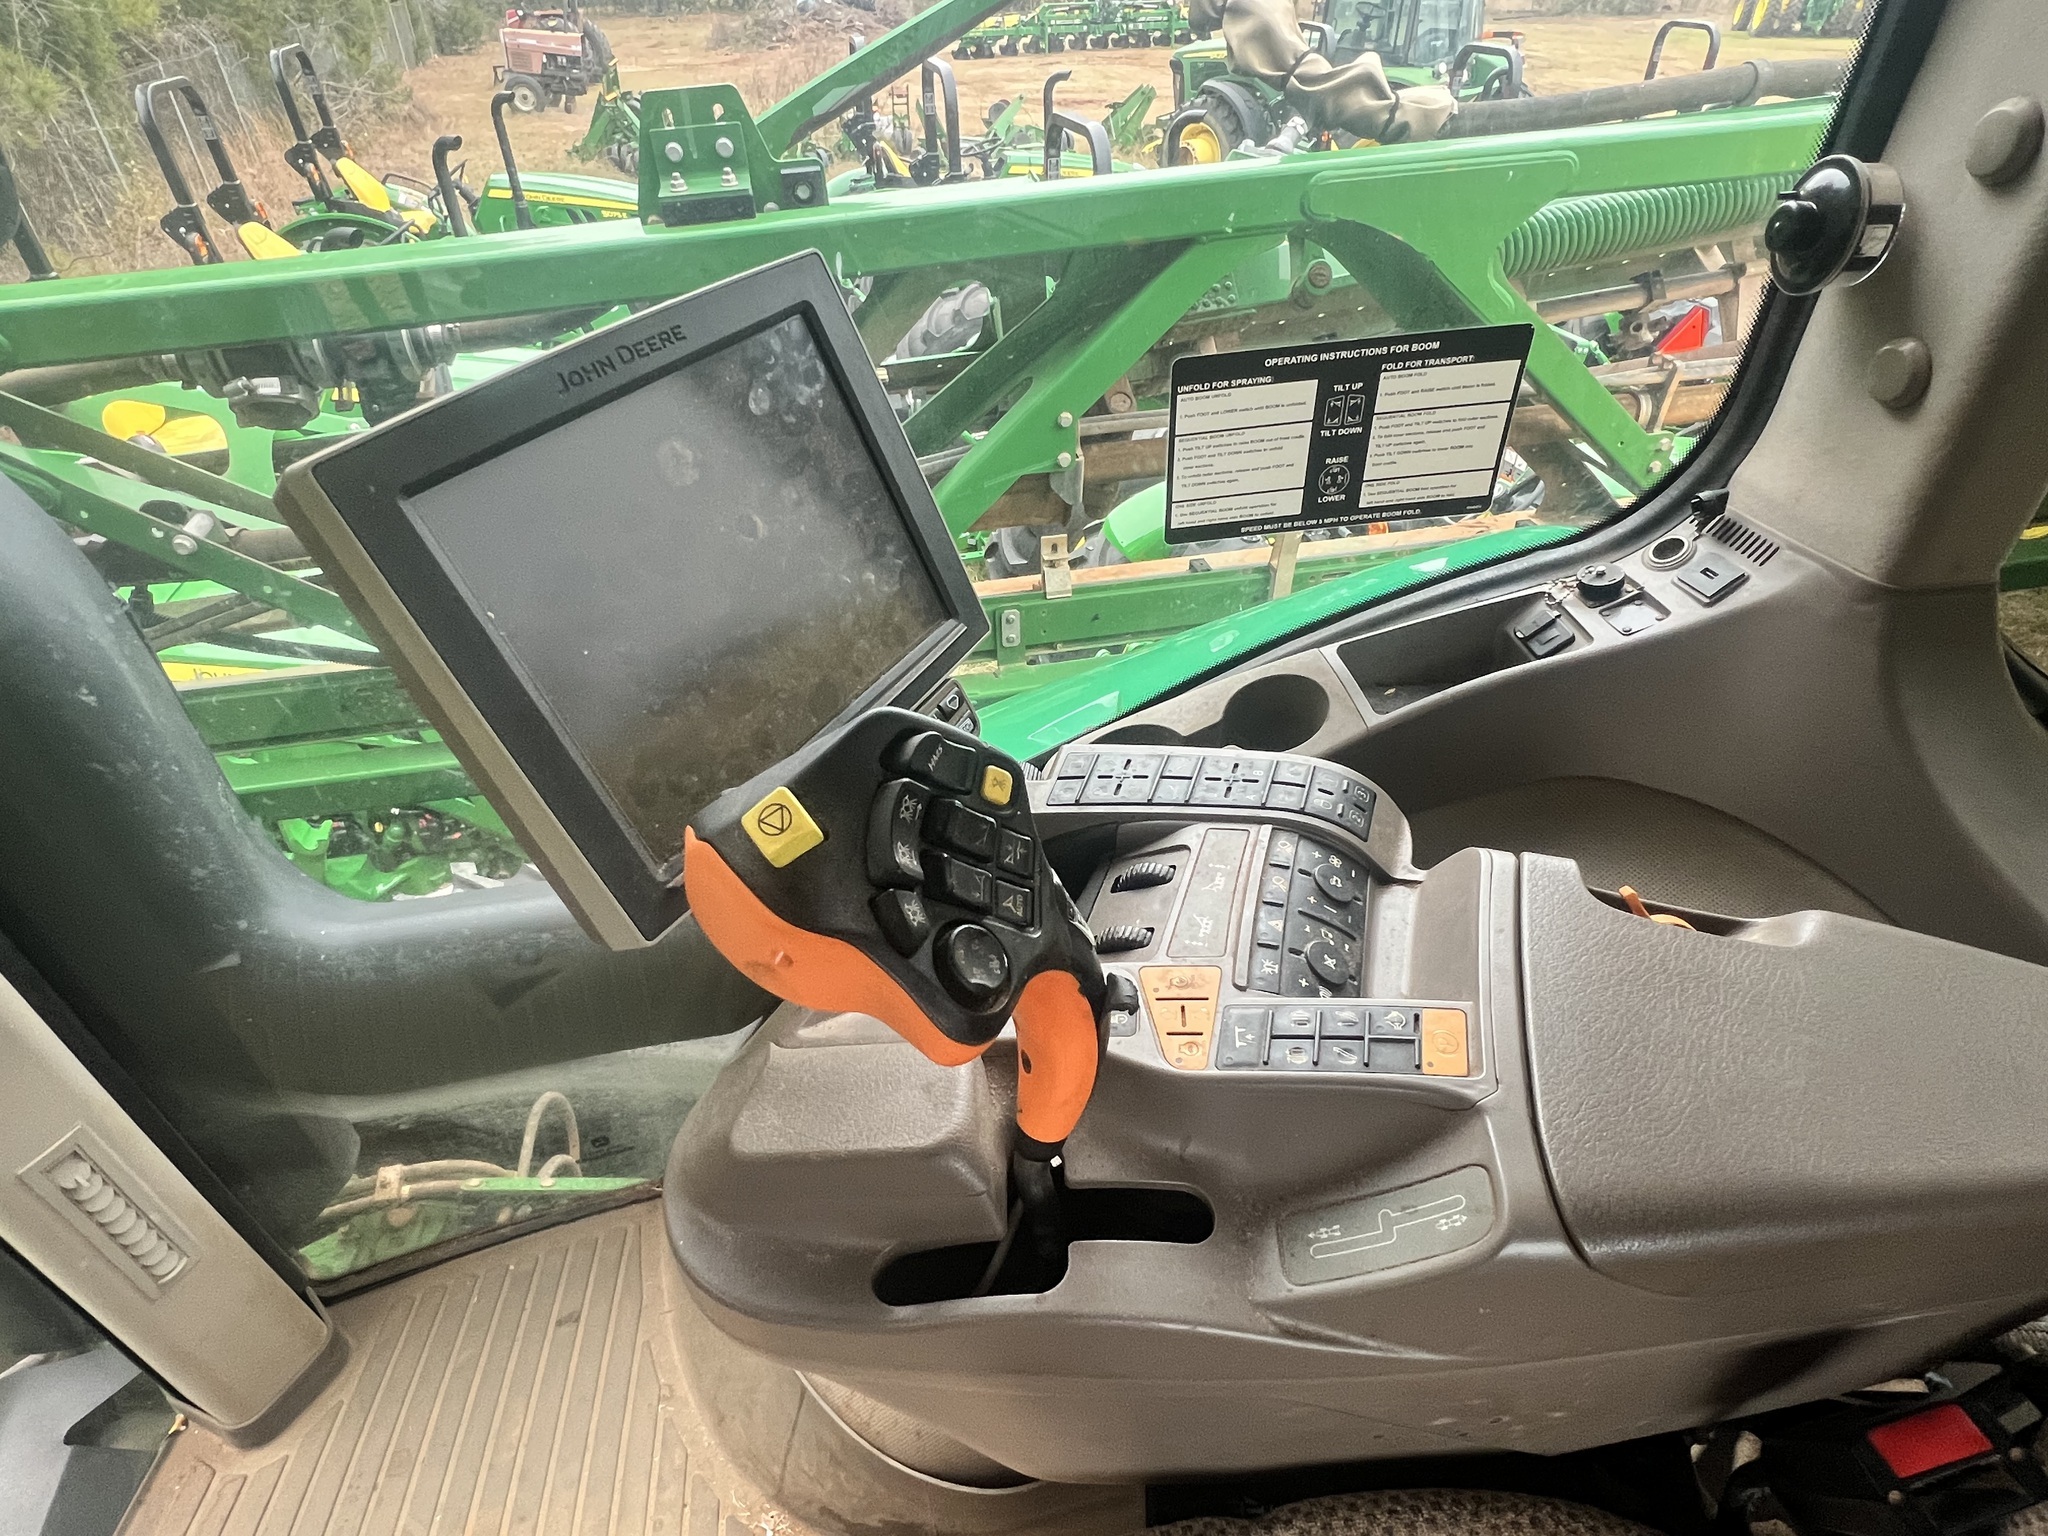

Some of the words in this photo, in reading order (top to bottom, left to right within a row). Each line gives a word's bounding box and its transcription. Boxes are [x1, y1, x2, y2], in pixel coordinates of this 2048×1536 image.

[556, 355, 617, 395] JOHN
[614, 324, 687, 366] DEERE
[1264, 353, 1318, 368] OPERATING
[1320, 346, 1388, 362] INSTRUCTIONS
[1390, 344, 1409, 354] FOR
[1411, 340, 1441, 352] BOOM
[1381, 361, 1403, 371] FOLD
[1405, 359, 1423, 368] FOR
[1177, 382, 1211, 393] UNFOLD
[1212, 380, 1230, 389] FOR
[1333, 384, 1350, 392] TILT
[1351, 382, 1364, 390] UP
[1320, 429, 1337, 437] TILT
[1338, 426, 1362, 436] DOWN
[1325, 455, 1349, 465] RAISE
[1317, 494, 1346, 503] LOWER
[1240, 525, 1263, 534] SPEED
[1263, 522, 1282, 531] MUST
[1283, 521, 1293, 529] BE
[1293, 518, 1318, 527] BELOW
[1323, 516, 1339, 524] MPH
[1339, 515, 1349, 523] TO
[1350, 512, 1381, 522] OPERATE
[1382, 510, 1402, 519] BOOM
[1356, 788, 1367, 799] 3
[1016, 894, 1024, 918] AUTO
